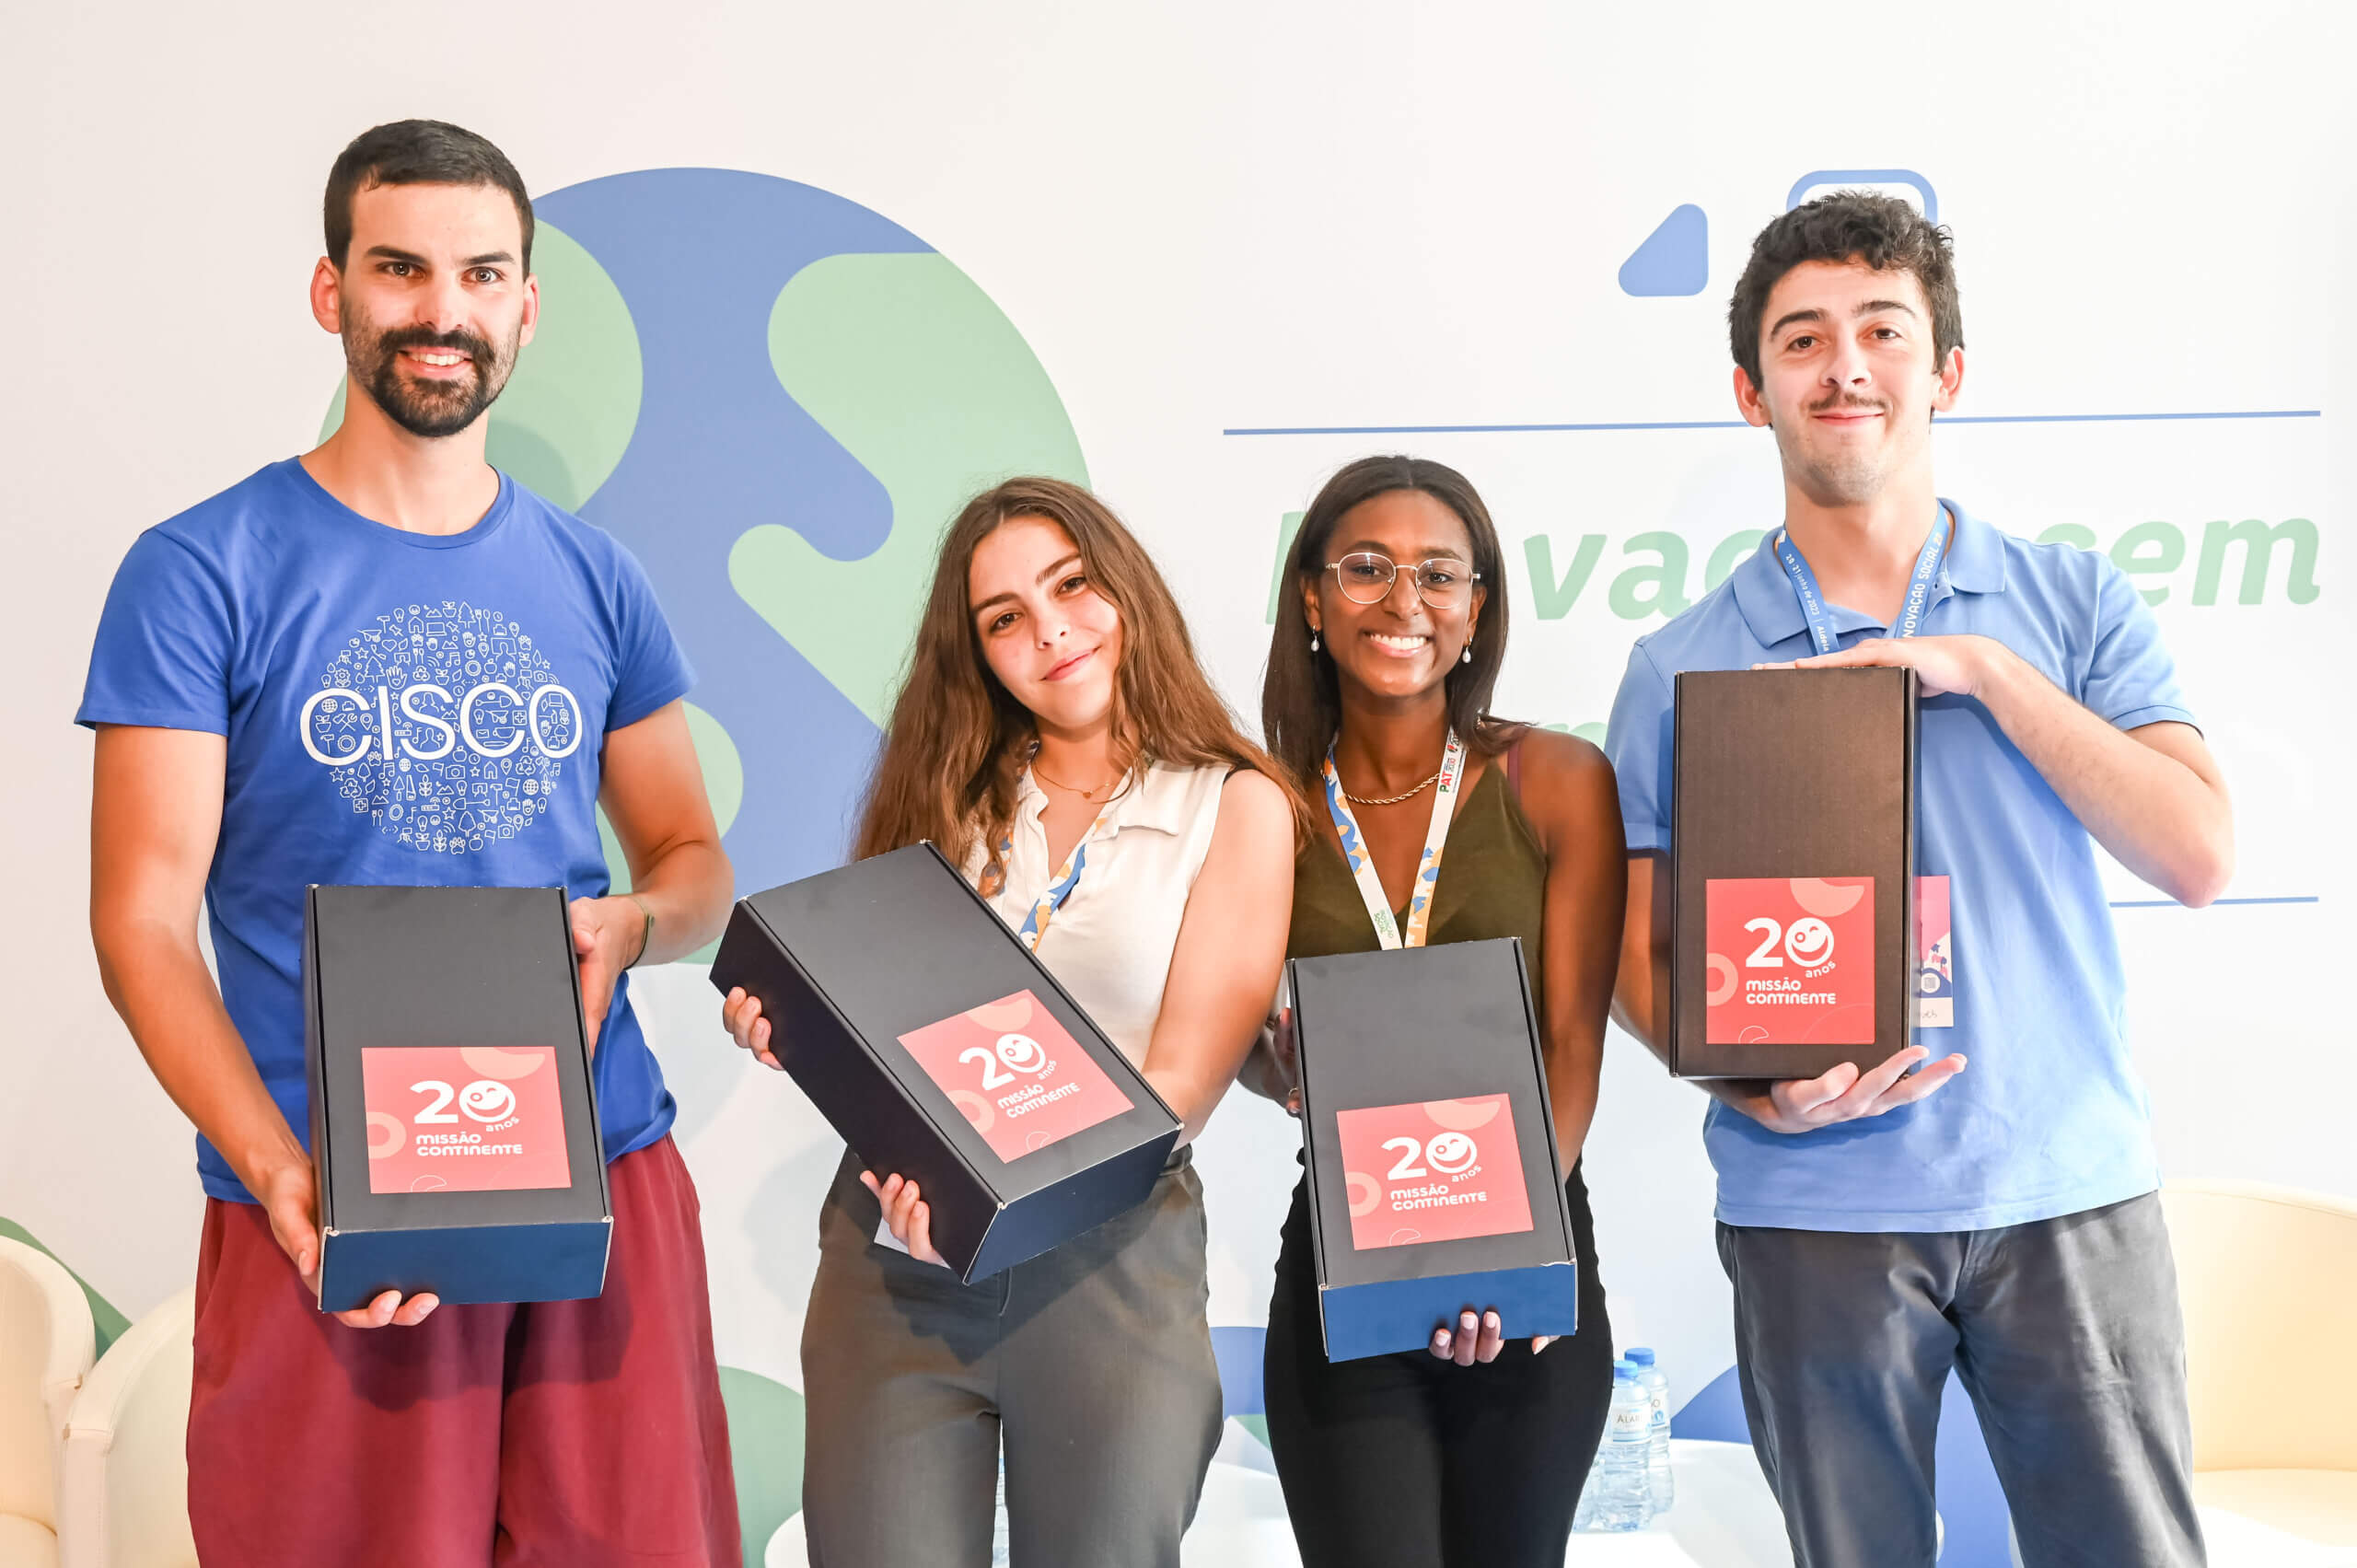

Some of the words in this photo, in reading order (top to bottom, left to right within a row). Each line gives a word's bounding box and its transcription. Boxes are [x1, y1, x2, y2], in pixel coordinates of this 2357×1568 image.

[1918, 546, 1940, 581] SOCIAL
[300, 682, 583, 766] CISCO
[1439, 770, 1453, 793] PAT
[1805, 960, 1837, 979] anos
[1746, 977, 1802, 992] MISSÃO
[1746, 993, 1837, 1005] CONTINENTE
[1037, 1059, 1057, 1081] anos
[997, 1084, 1045, 1109] MISSÃO
[1006, 1082, 1082, 1119] CONTINENTE
[485, 1116, 520, 1132] anos
[416, 1132, 482, 1144] MISSÃO
[416, 1144, 524, 1156] CONTINENTE
[1451, 1165, 1482, 1182] anos
[1390, 1183, 1449, 1201] MISSÃO
[1392, 1191, 1488, 1212] CONTINENTE
